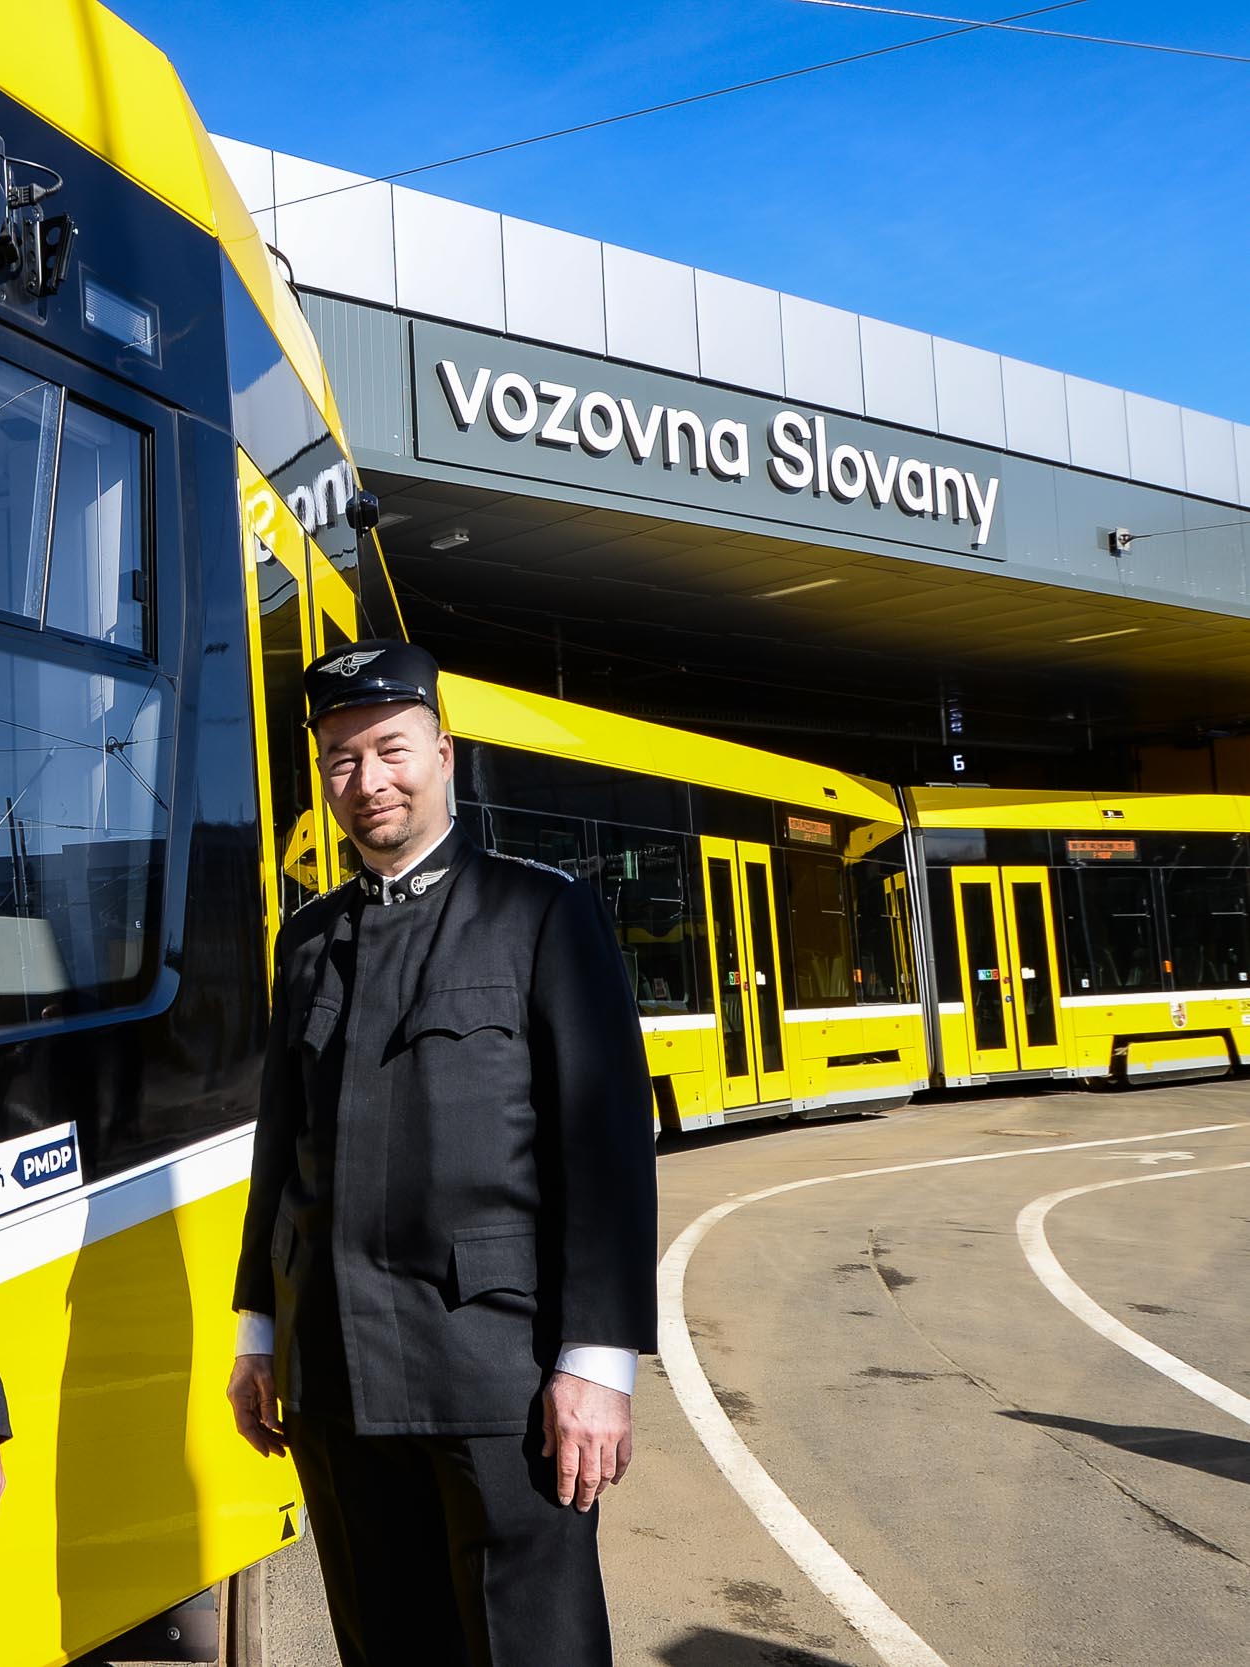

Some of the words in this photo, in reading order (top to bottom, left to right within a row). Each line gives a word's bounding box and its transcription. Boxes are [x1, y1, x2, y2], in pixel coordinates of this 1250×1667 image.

[767, 411, 999, 545] Slovany
[953, 754, 965, 771] 6
[23, 1146, 72, 1181] PMDP
